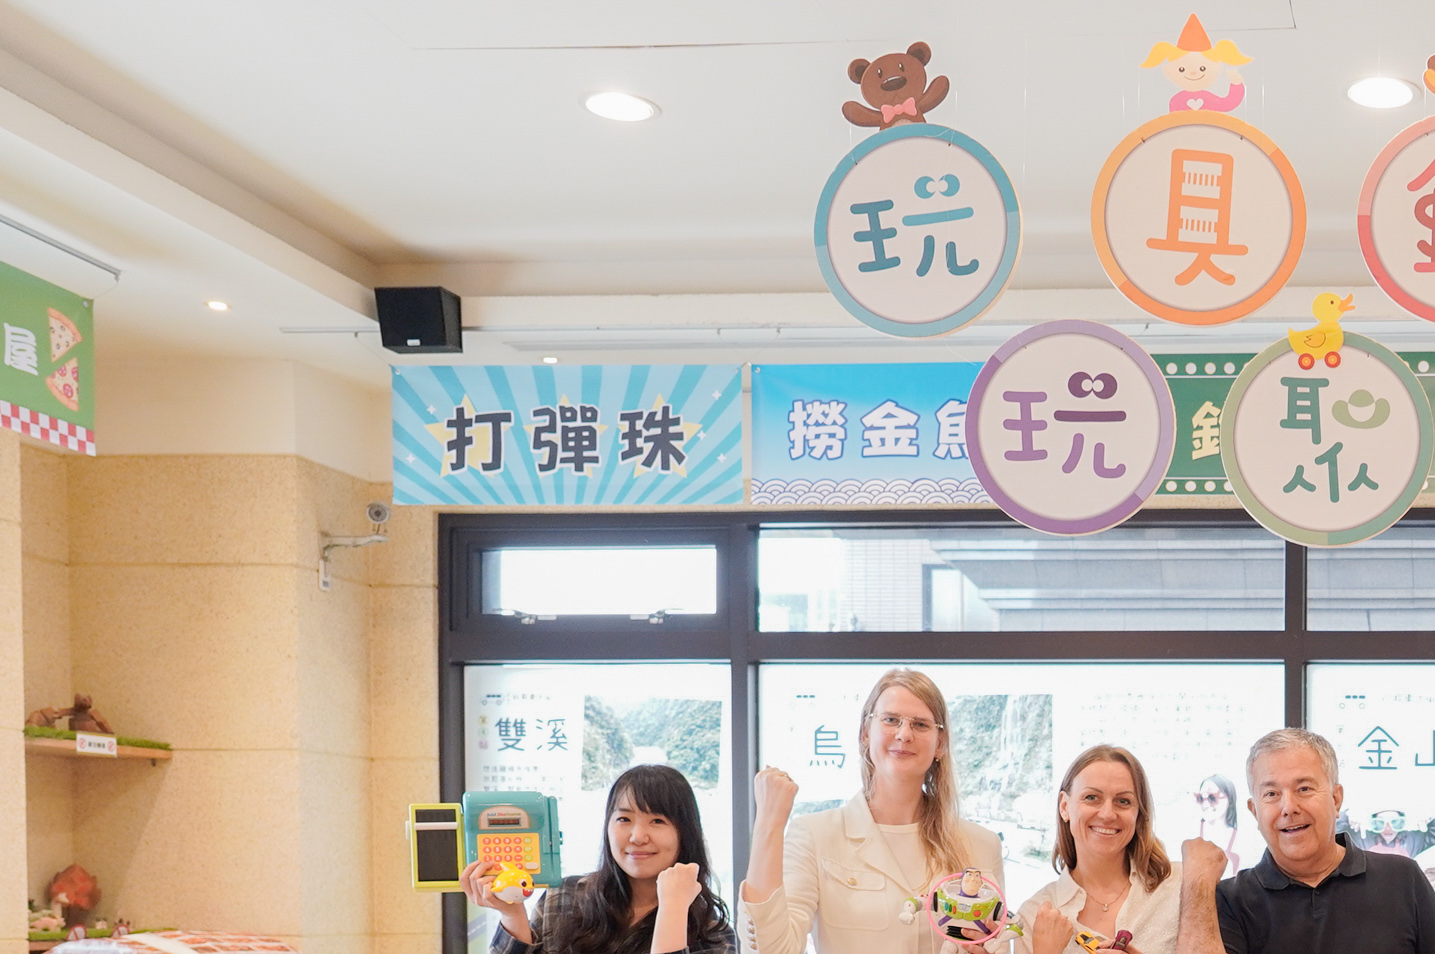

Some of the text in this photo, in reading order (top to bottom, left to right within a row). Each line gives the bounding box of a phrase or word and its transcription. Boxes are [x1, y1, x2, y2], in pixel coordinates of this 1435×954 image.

[1146, 148, 1249, 286] 具
[445, 403, 688, 476] 打彈珠
[495, 717, 568, 751] 雙溪
